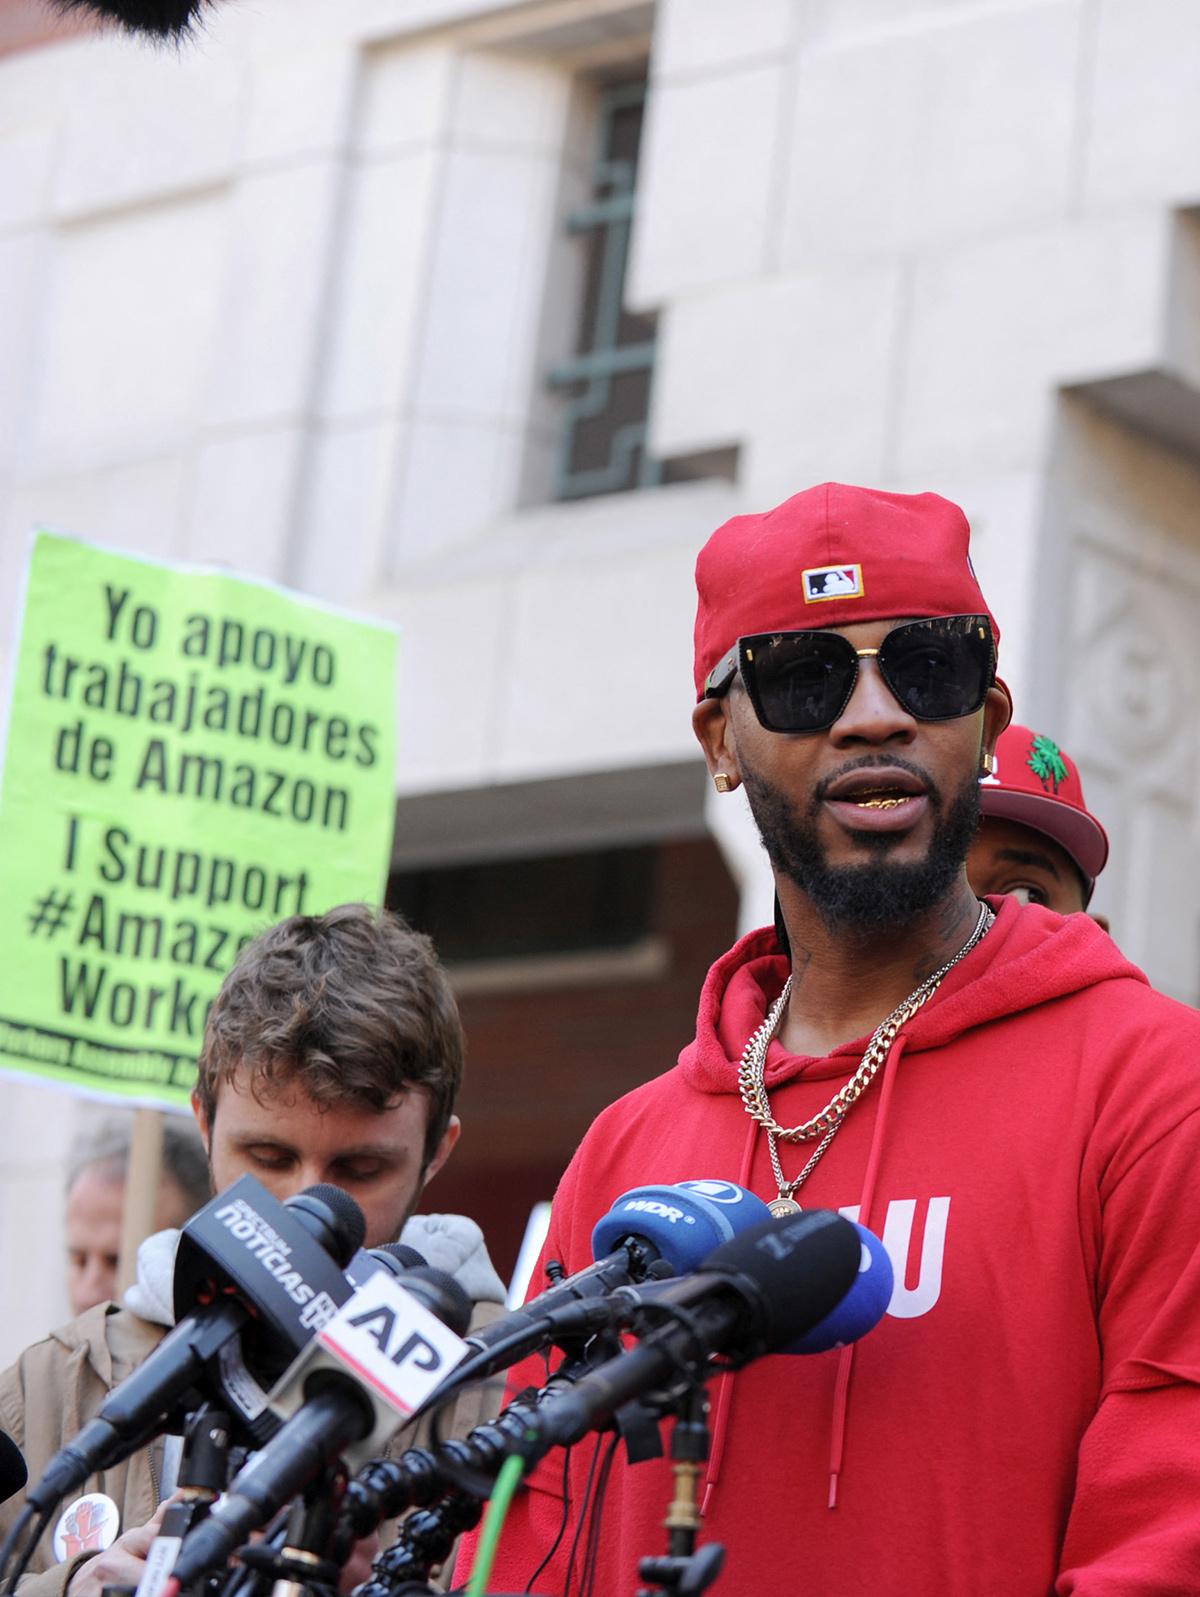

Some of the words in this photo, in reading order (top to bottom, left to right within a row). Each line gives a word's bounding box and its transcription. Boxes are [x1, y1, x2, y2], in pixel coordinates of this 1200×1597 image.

[104, 582, 159, 651] Yo
[182, 611, 335, 687] apoyo
[42, 643, 379, 768] trabajadores
[55, 720, 115, 782] de
[136, 740, 350, 833] Amazon
[64, 817, 79, 874] I
[100, 826, 309, 916] Support
[27, 886, 250, 975] #Amaz
[59, 956, 216, 1040] Work
[623, 1199, 685, 1224] WDR
[347, 1302, 442, 1373] AP
